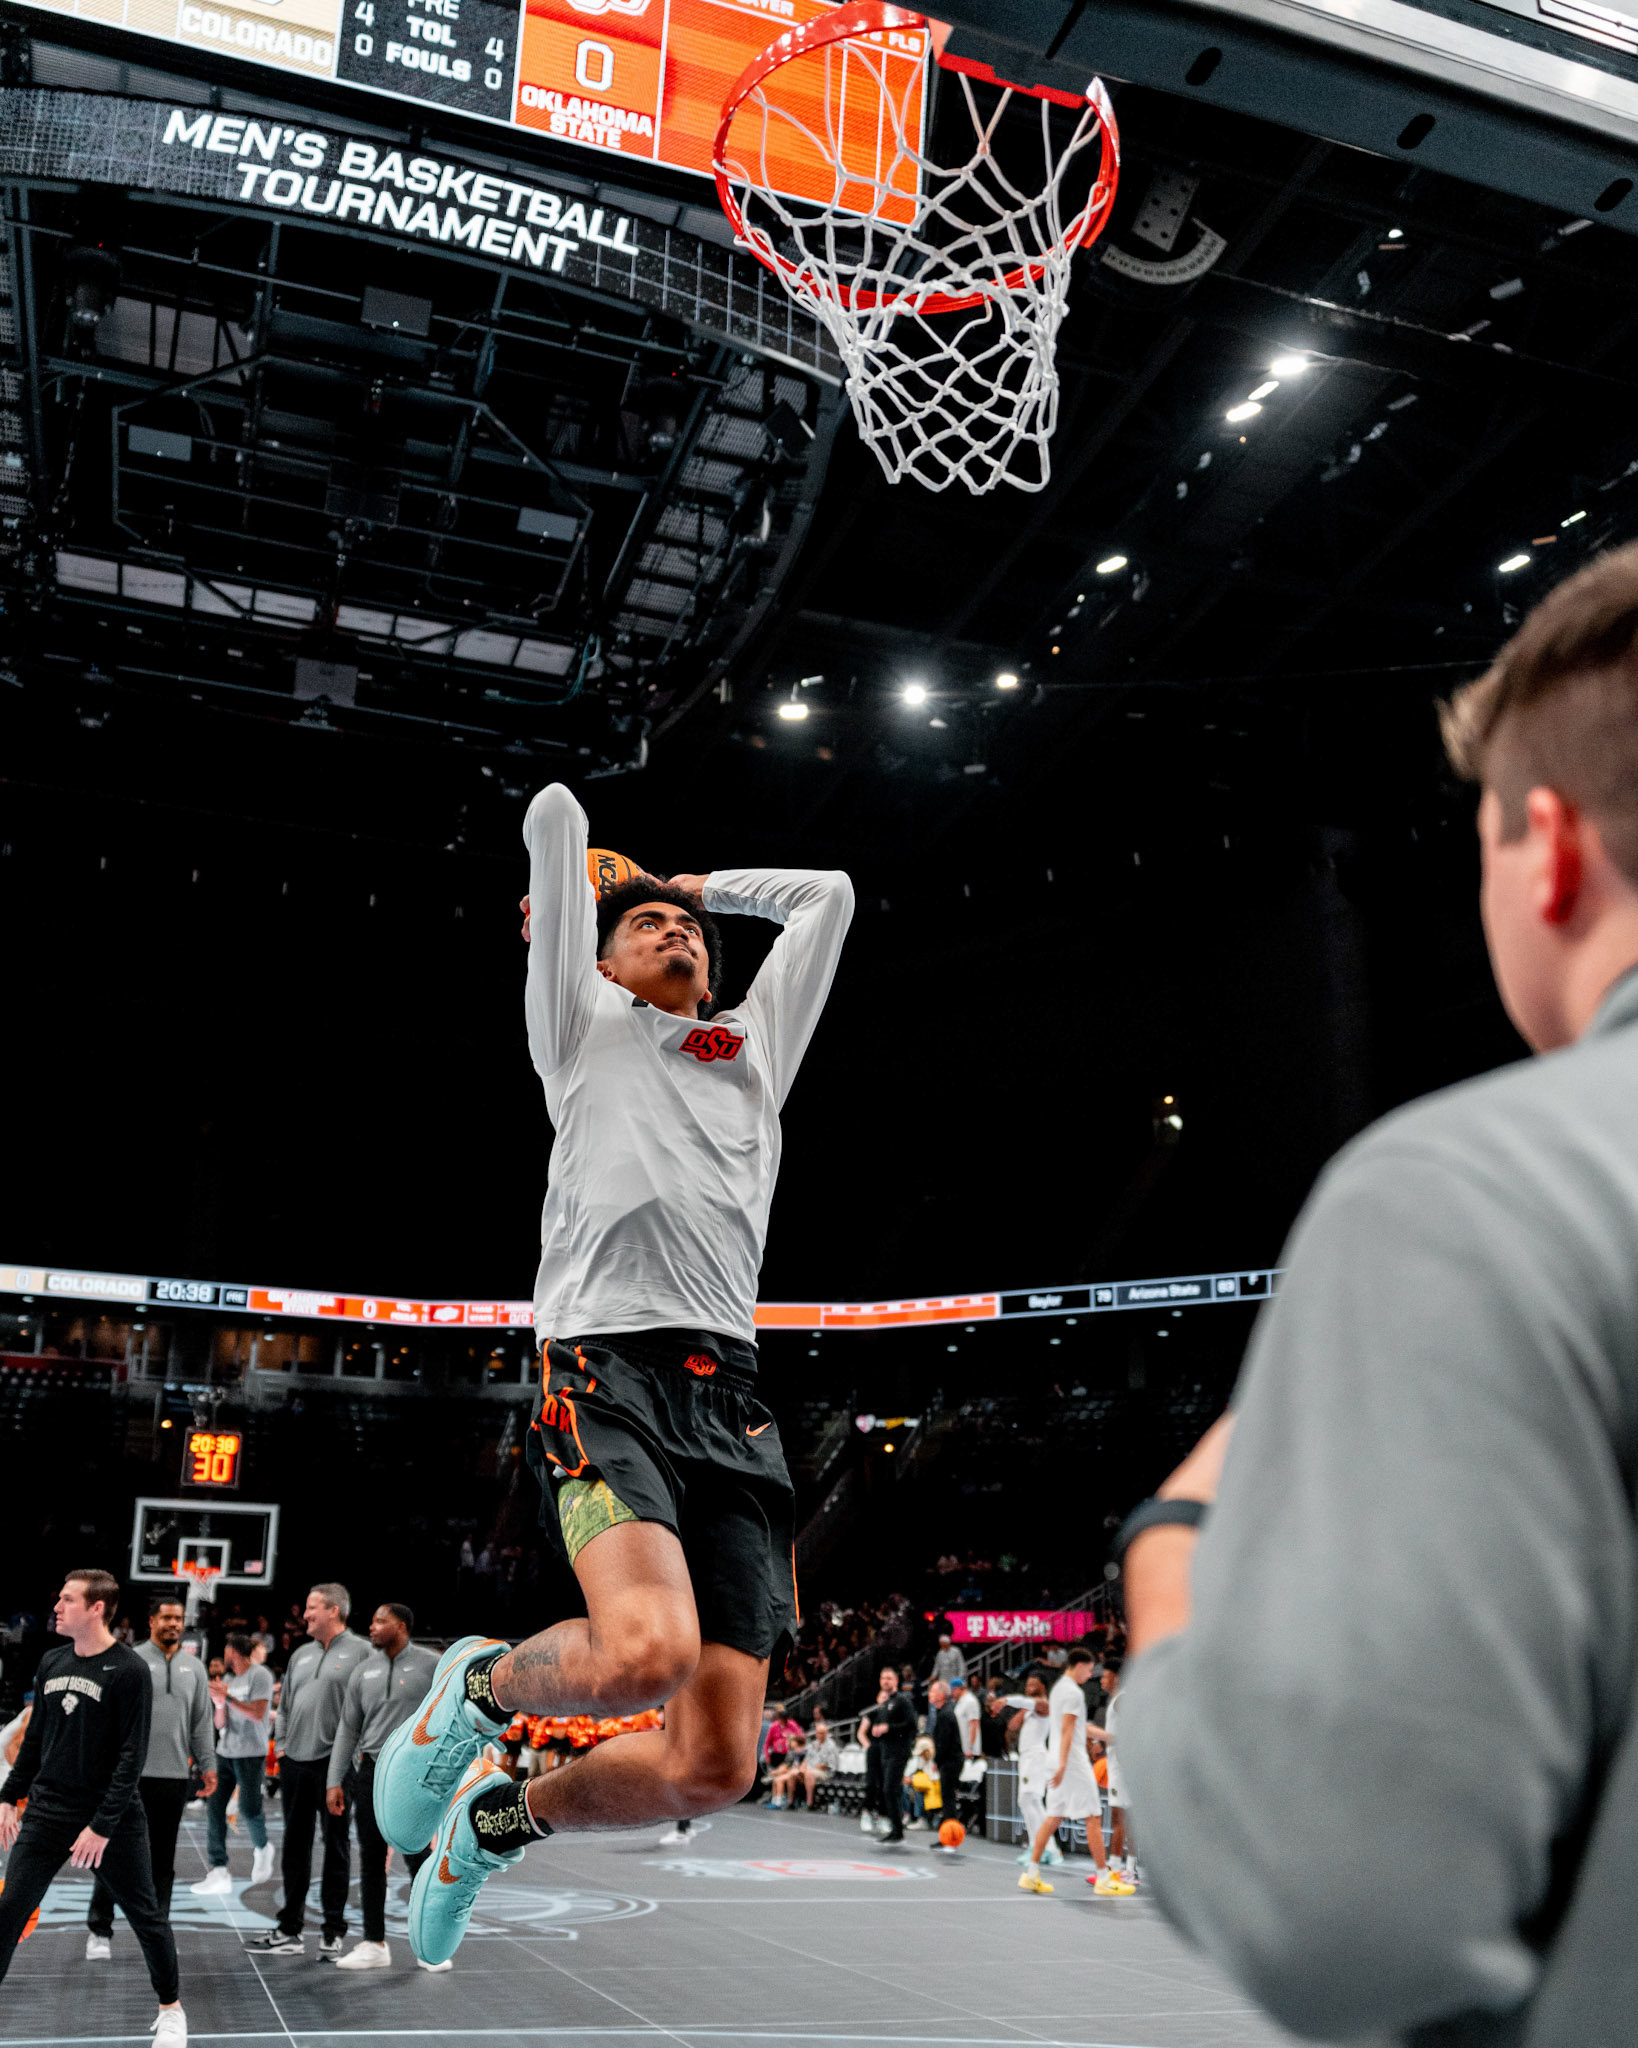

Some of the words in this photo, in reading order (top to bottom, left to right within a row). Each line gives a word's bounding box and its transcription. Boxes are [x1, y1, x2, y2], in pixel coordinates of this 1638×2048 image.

[180, 5, 334, 67] COLORADO
[354, 1, 375, 27] 4
[406, 15, 457, 48] TOL
[485, 37, 504, 62] 4
[888, 31, 920, 53] FLS
[355, 33, 373, 56] 0
[385, 41, 472, 82] FOULS
[484, 67, 503, 90] 0
[575, 39, 615, 92] 0
[521, 85, 653, 137] OKLAHOMA
[550, 112, 622, 149] STATE
[162, 109, 328, 169] MEN'S
[338, 142, 639, 257] BASKETBALL
[236, 162, 579, 272] TOURNAMENT
[47, 1275, 143, 1298] COLORADO
[190, 1433, 240, 1455] 20:38
[192, 1452, 234, 1483] 30
